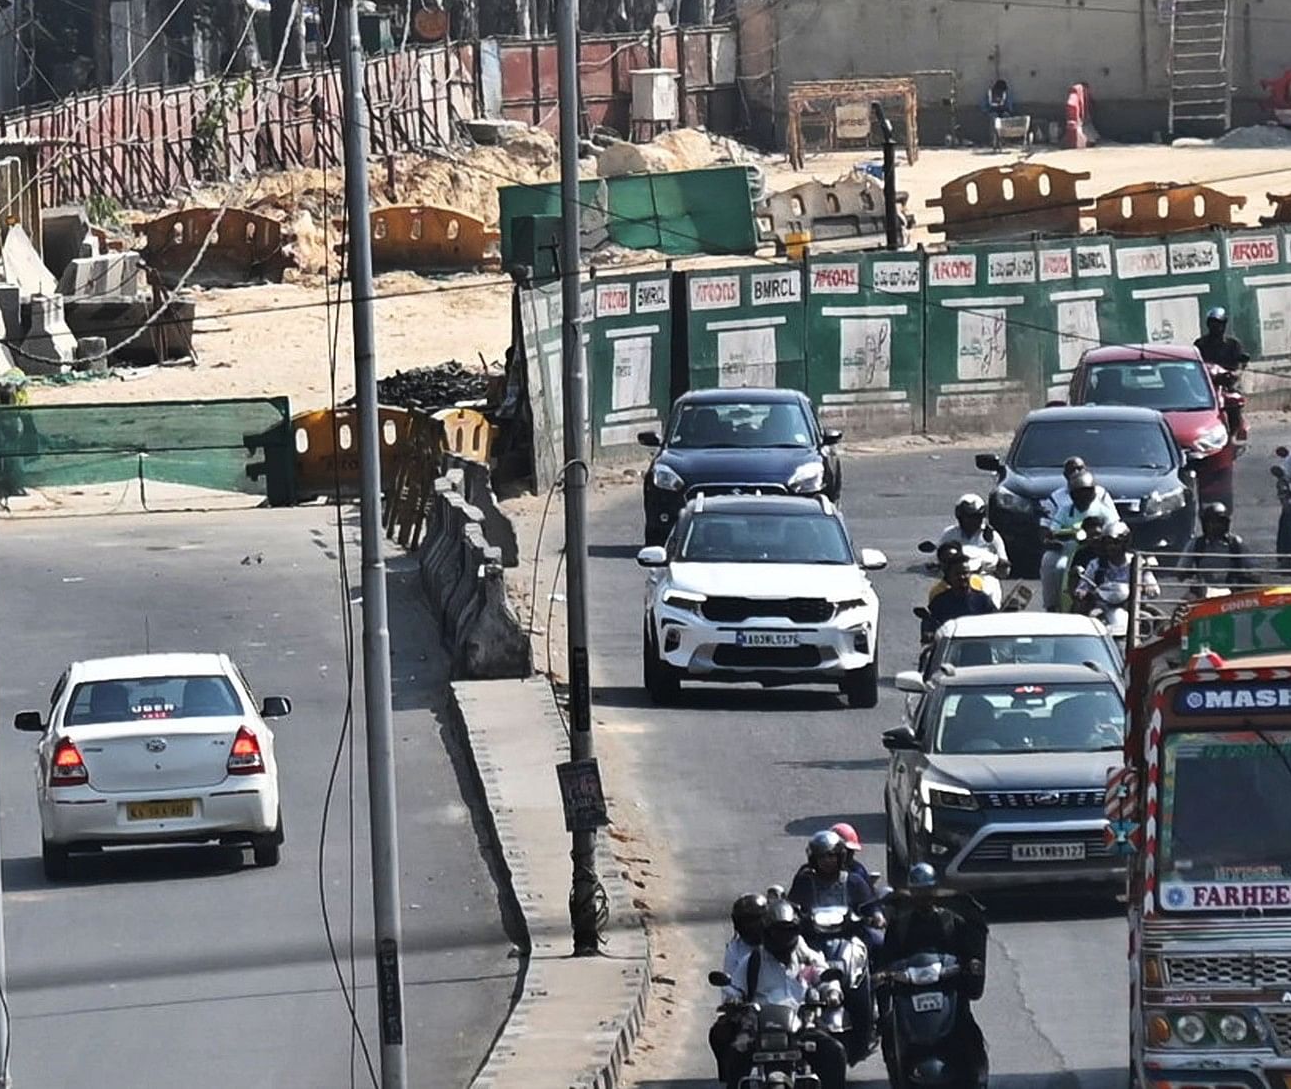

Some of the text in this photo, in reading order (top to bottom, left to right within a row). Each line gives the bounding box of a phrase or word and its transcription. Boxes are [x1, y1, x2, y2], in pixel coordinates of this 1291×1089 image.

[1231, 241, 1275, 260] AFCONS
[637, 284, 667, 307] BMRCL
[754, 277, 796, 300] BMRCL
[1221, 598, 1260, 613] GOODS
